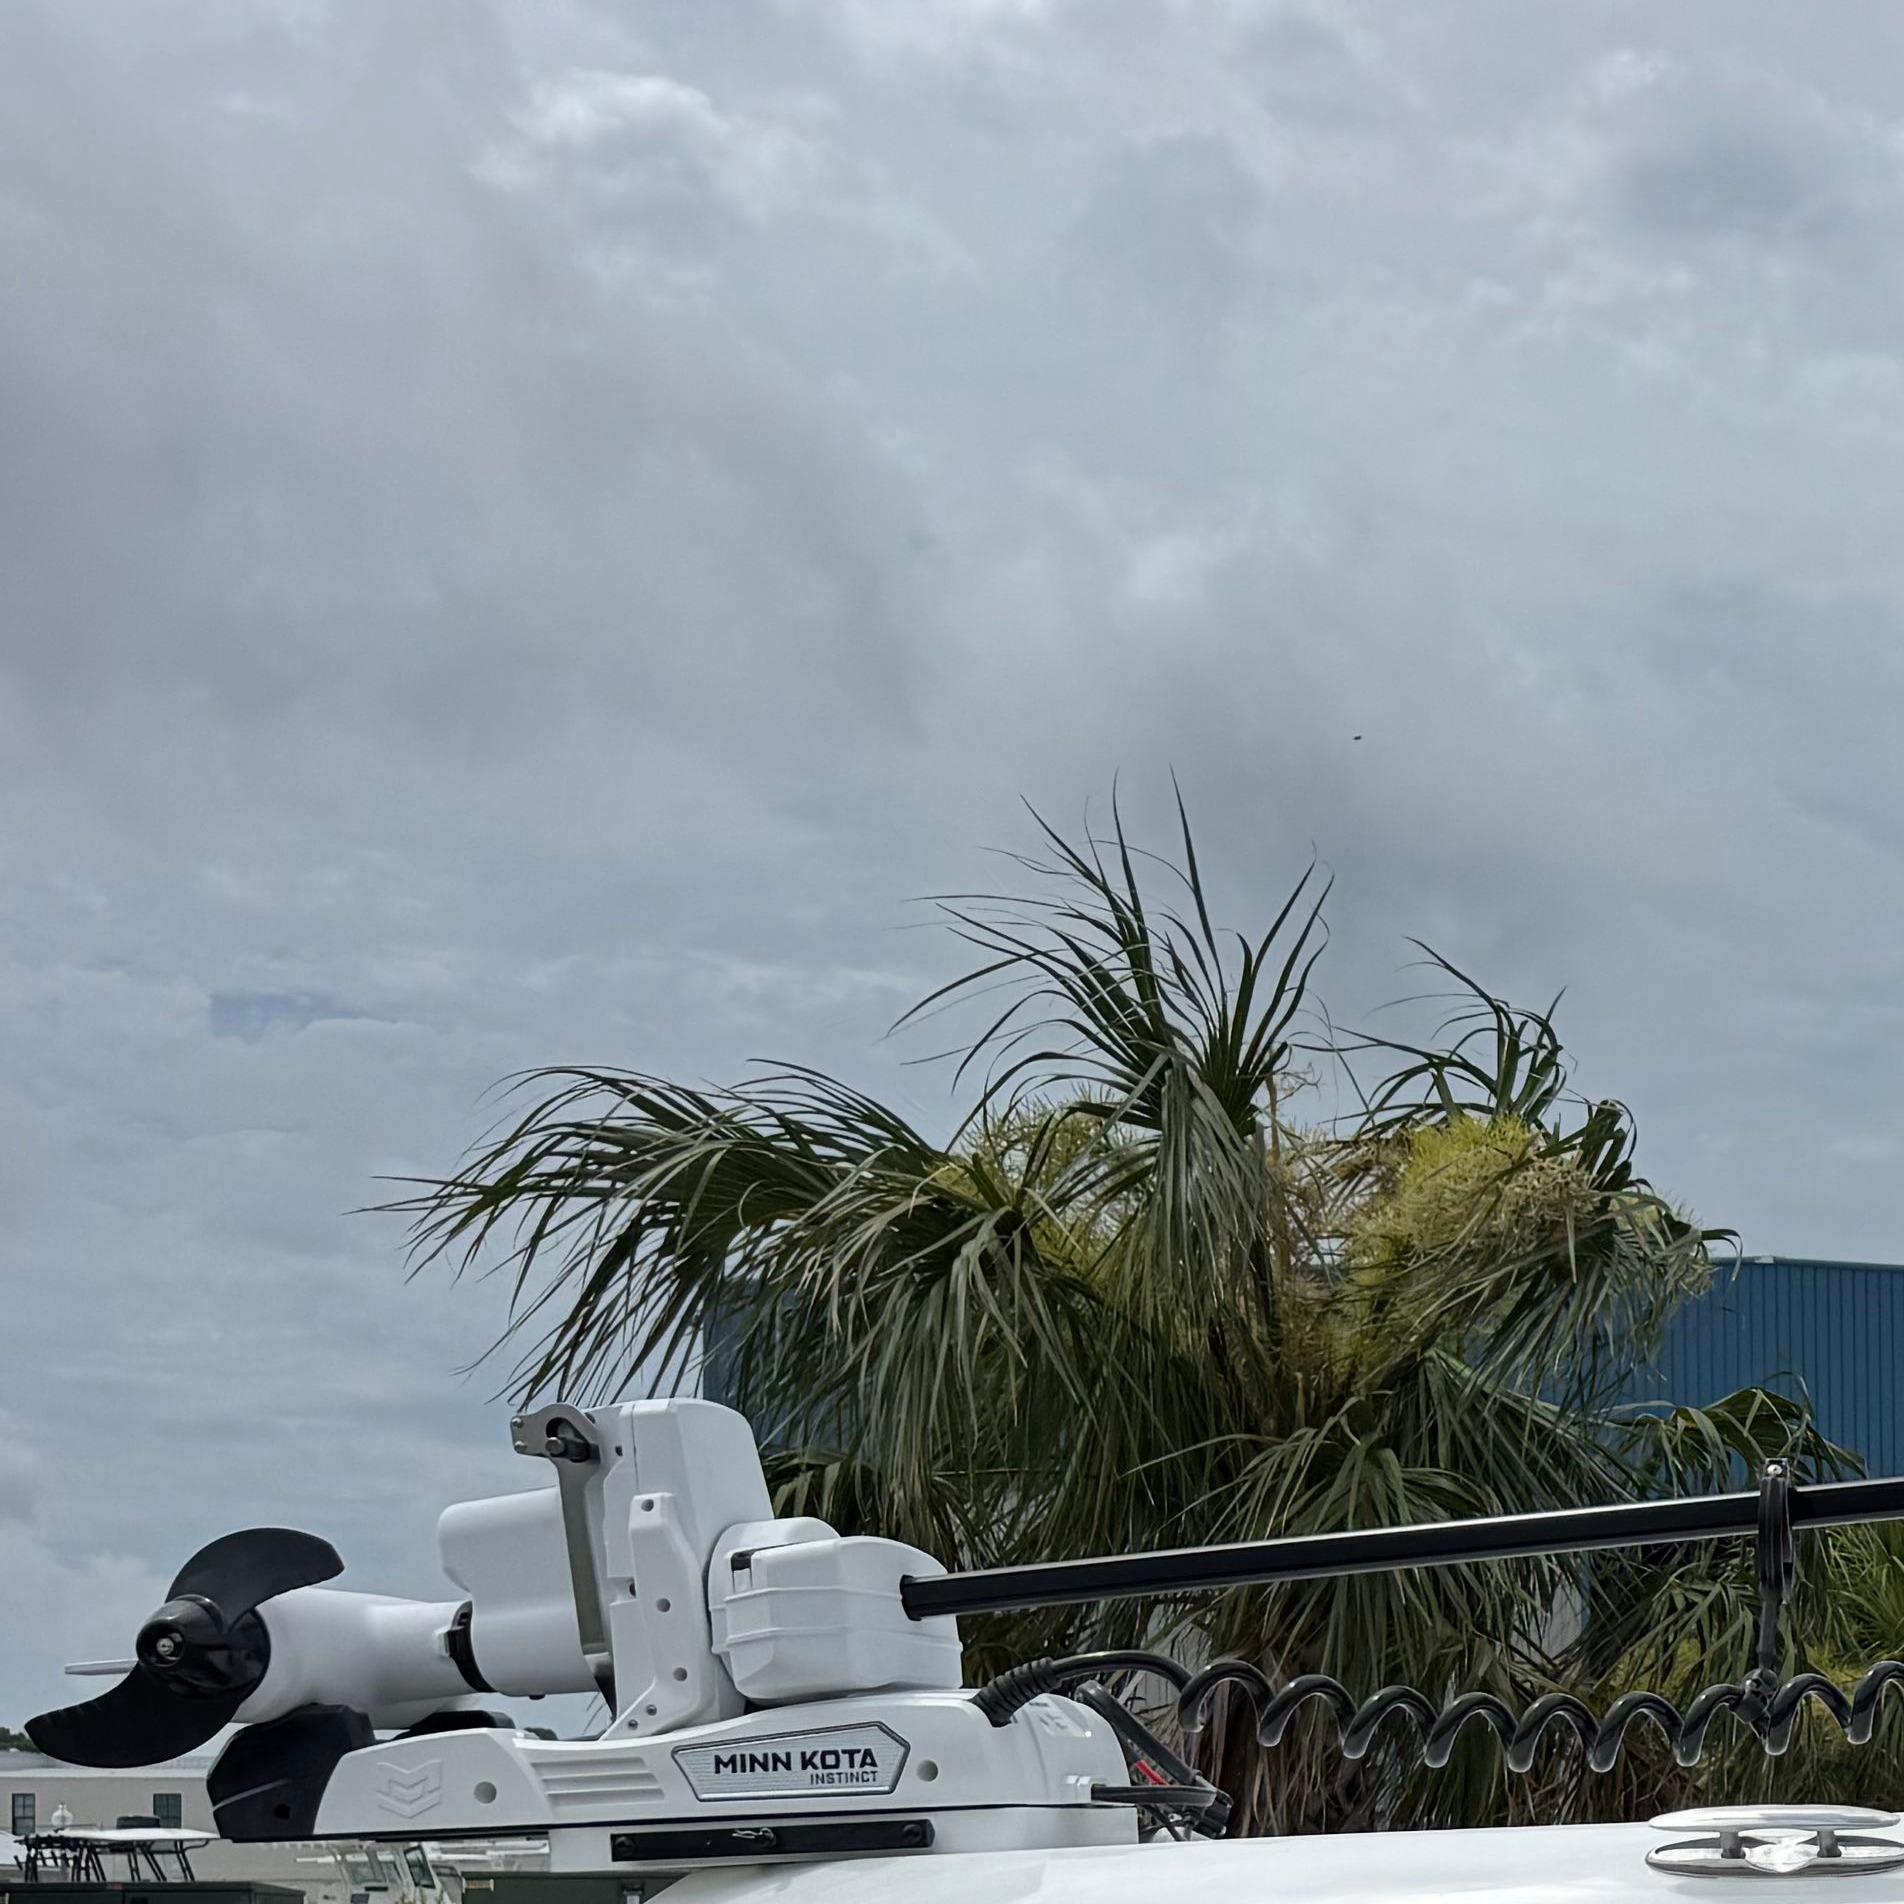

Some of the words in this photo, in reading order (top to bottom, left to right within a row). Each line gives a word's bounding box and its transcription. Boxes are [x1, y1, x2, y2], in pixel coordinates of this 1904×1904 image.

[714, 1751, 792, 1774] MINN
[801, 1748, 878, 1771] KOTA
[810, 1770, 878, 1785] INSTINCT
